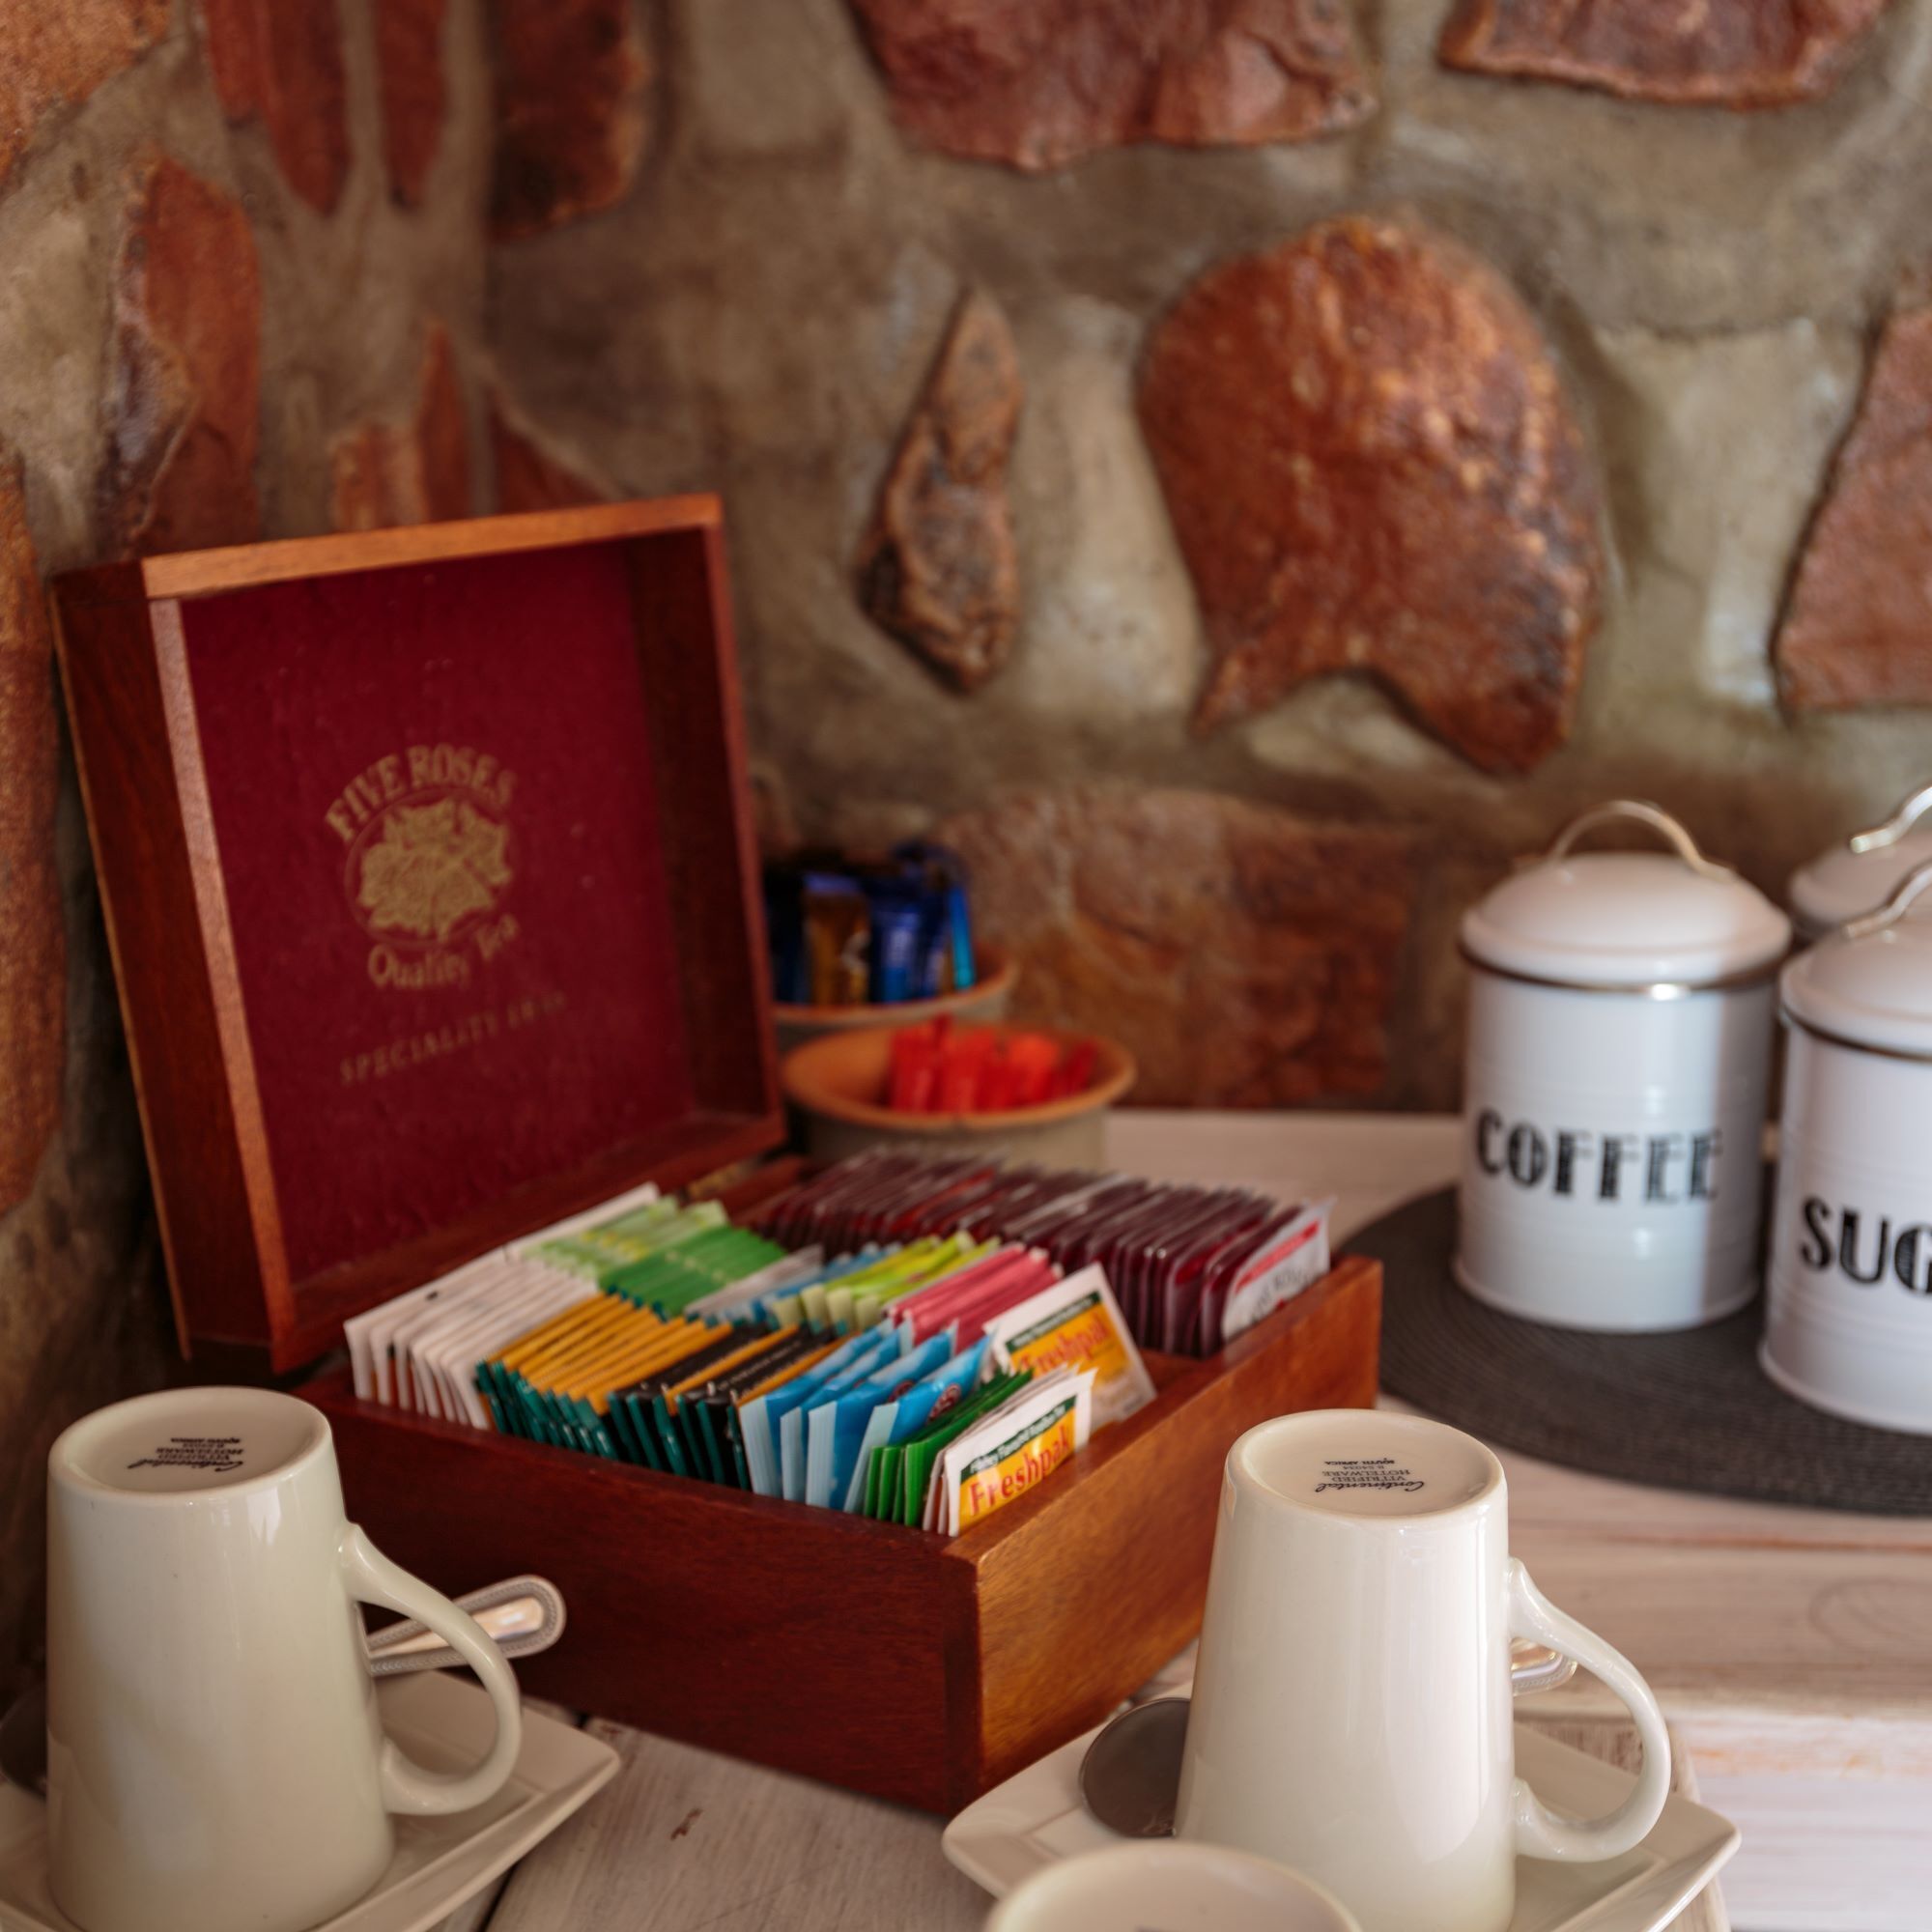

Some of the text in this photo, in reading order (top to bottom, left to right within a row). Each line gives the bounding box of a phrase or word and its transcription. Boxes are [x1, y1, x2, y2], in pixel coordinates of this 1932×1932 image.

[326, 742, 516, 841] FIVE ROSES
[1476, 1108, 1722, 1202] COFFEE
[1800, 1195, 1932, 1295] SUG
[1315, 1481, 1424, 1492] Continental
